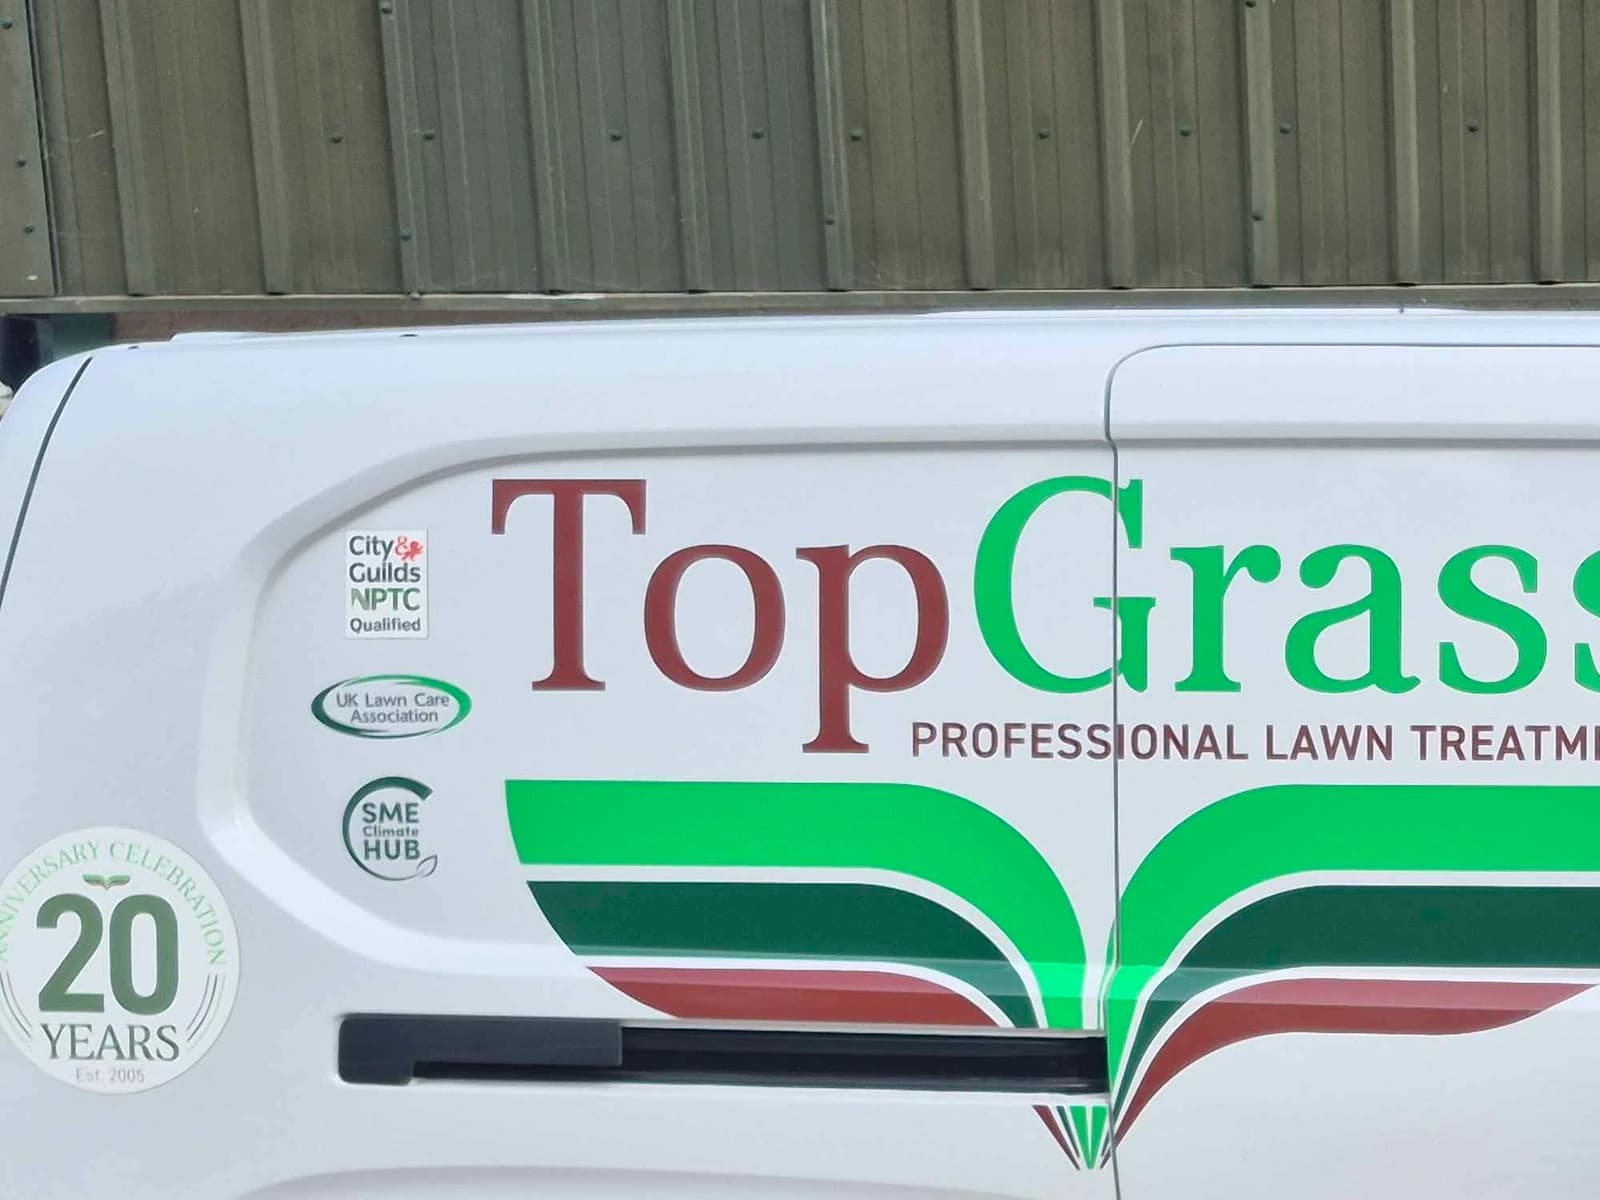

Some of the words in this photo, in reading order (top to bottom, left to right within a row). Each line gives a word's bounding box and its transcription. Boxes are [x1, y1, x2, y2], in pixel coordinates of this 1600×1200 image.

[349, 562, 421, 583] Guilds
[351, 588, 421, 611] NPTC
[350, 617, 421, 634] Qualified
[336, 692, 359, 709] UK
[365, 692, 408, 708] Lawn
[414, 691, 450, 708] Care
[351, 709, 438, 724] Association
[911, 722, 1248, 762] PROFESSIONAL
[1265, 723, 1393, 762] LAWN
[362, 802, 420, 824] SME
[363, 826, 420, 838] Climate
[363, 839, 421, 860] HUB
[109, 840, 227, 965] CELEBRATION
[36, 893, 180, 1015] 20
[41, 1023, 180, 1062] YEARS
